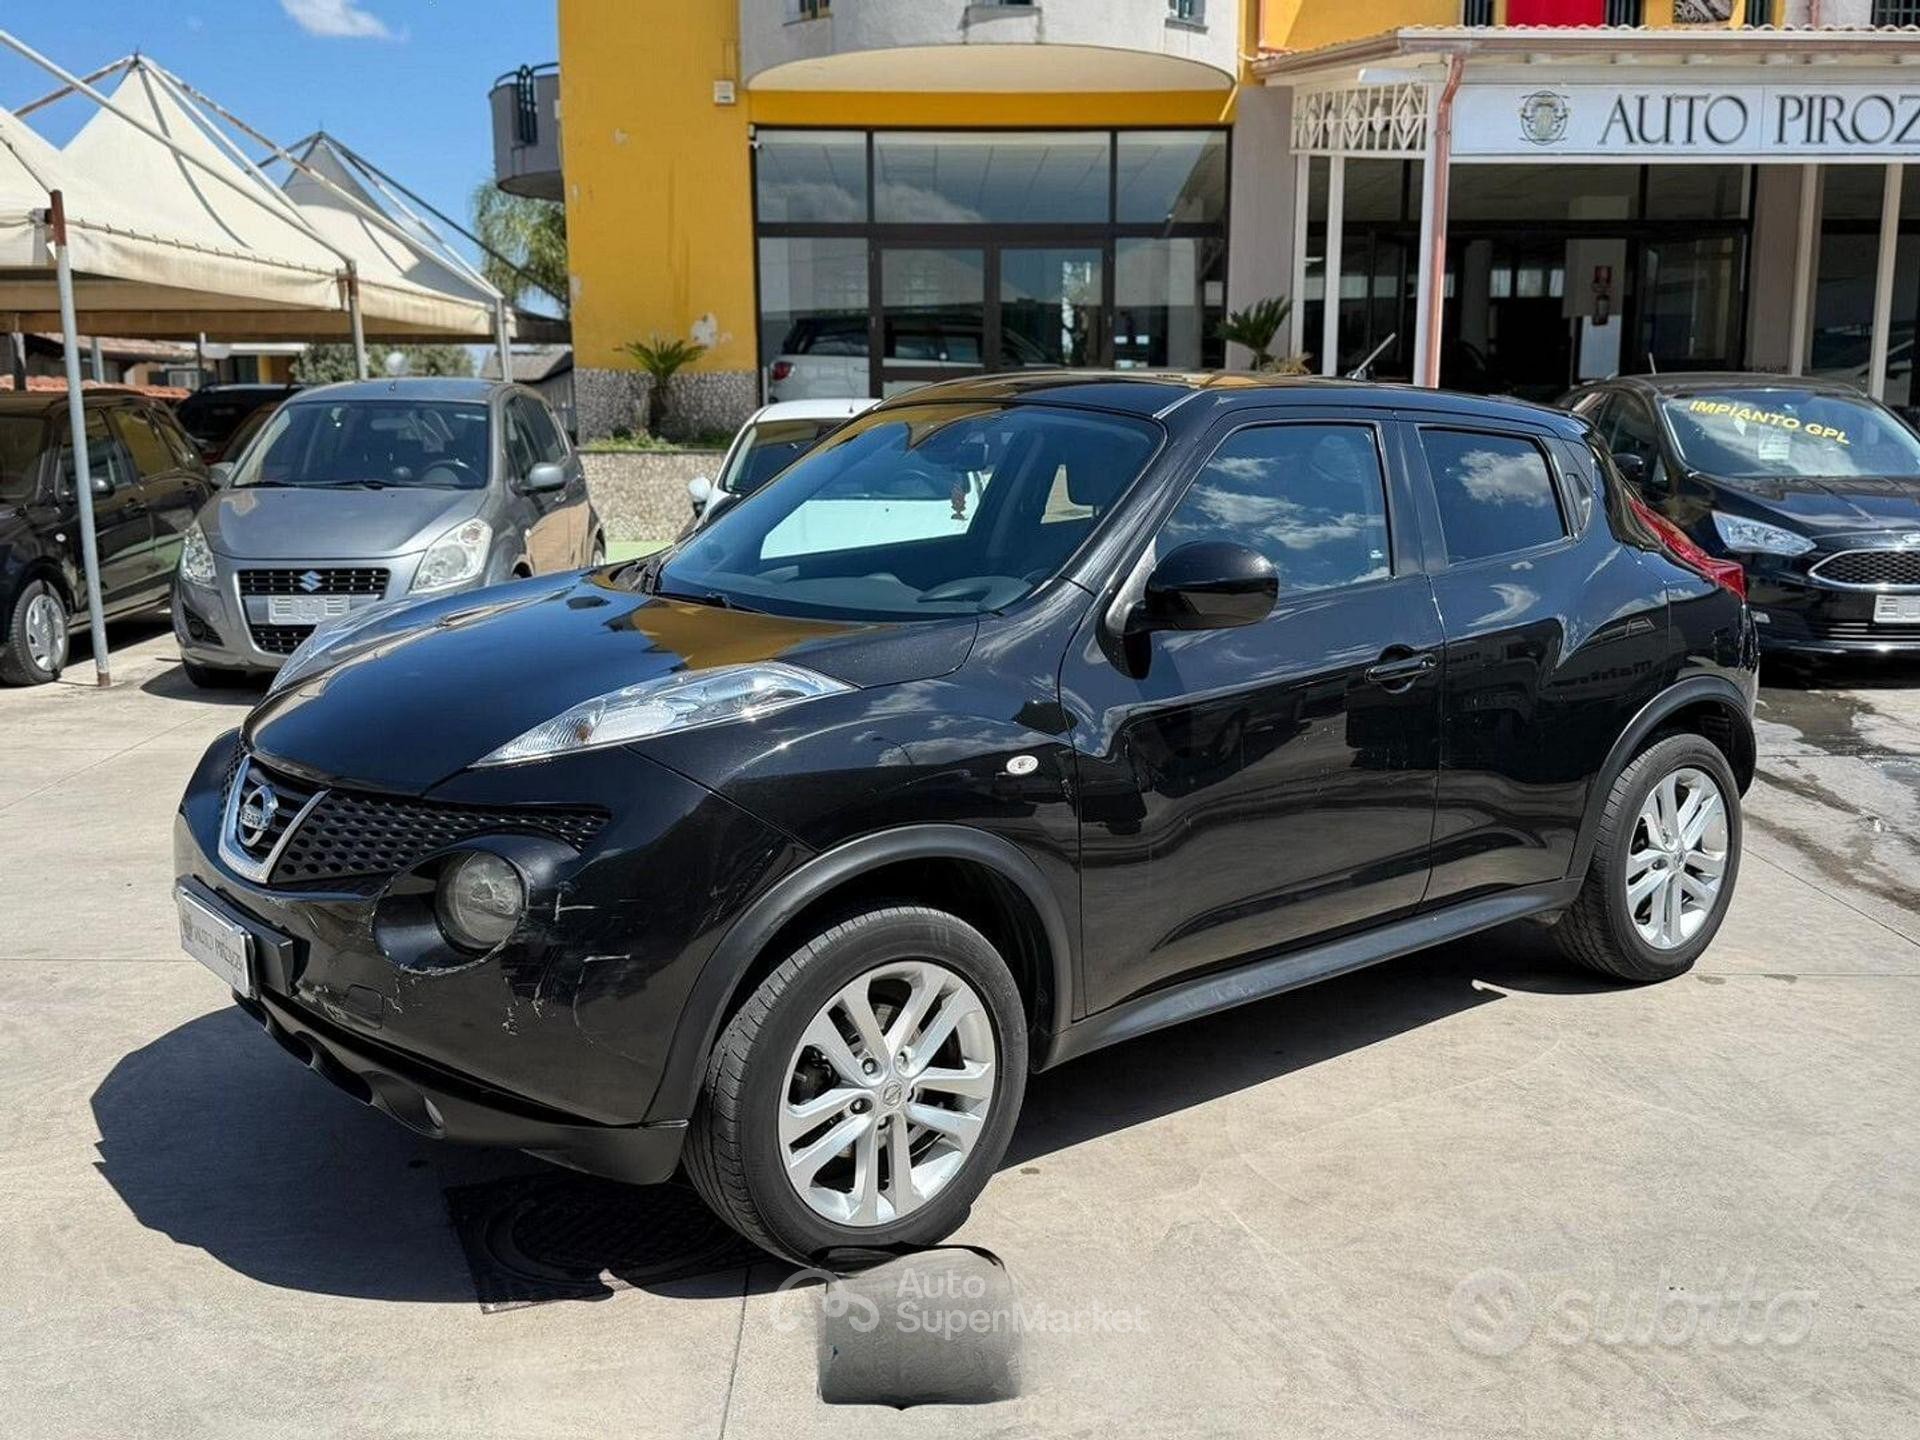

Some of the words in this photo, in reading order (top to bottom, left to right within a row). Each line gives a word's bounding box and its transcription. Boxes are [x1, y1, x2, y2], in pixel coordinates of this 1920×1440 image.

[1598, 93, 1748, 145] AUTO
[1774, 93, 1920, 145] PIROZ
[1688, 399, 1801, 429] IMPIANTO
[1804, 422, 1851, 446] GPL
